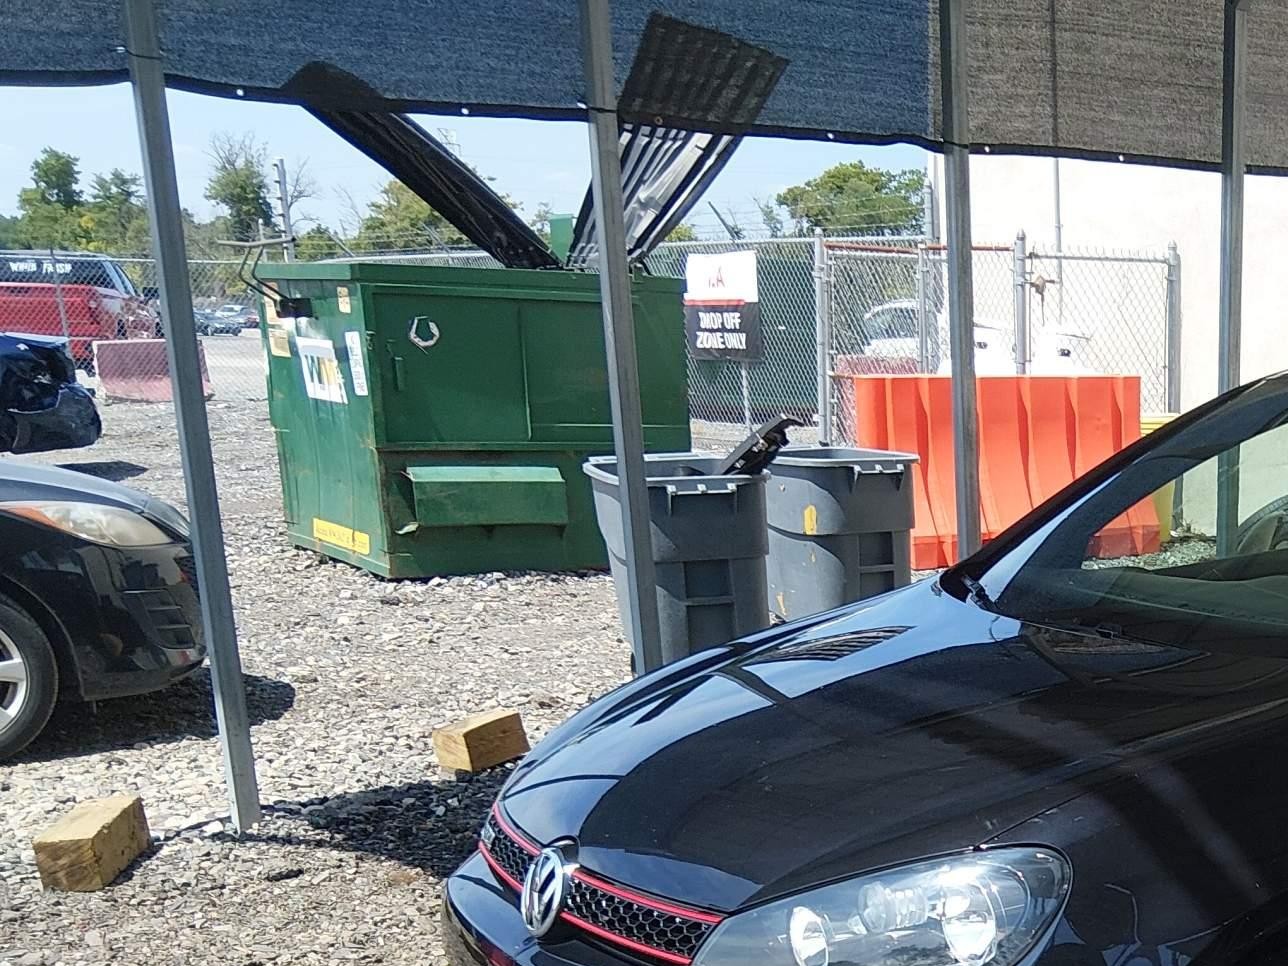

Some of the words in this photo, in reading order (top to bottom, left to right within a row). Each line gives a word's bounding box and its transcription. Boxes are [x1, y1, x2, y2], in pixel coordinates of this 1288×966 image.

[698, 312, 722, 329] DROP
[723, 312, 741, 329] OFF
[696, 331, 725, 349] ZONE
[724, 333, 747, 350] ONLY
